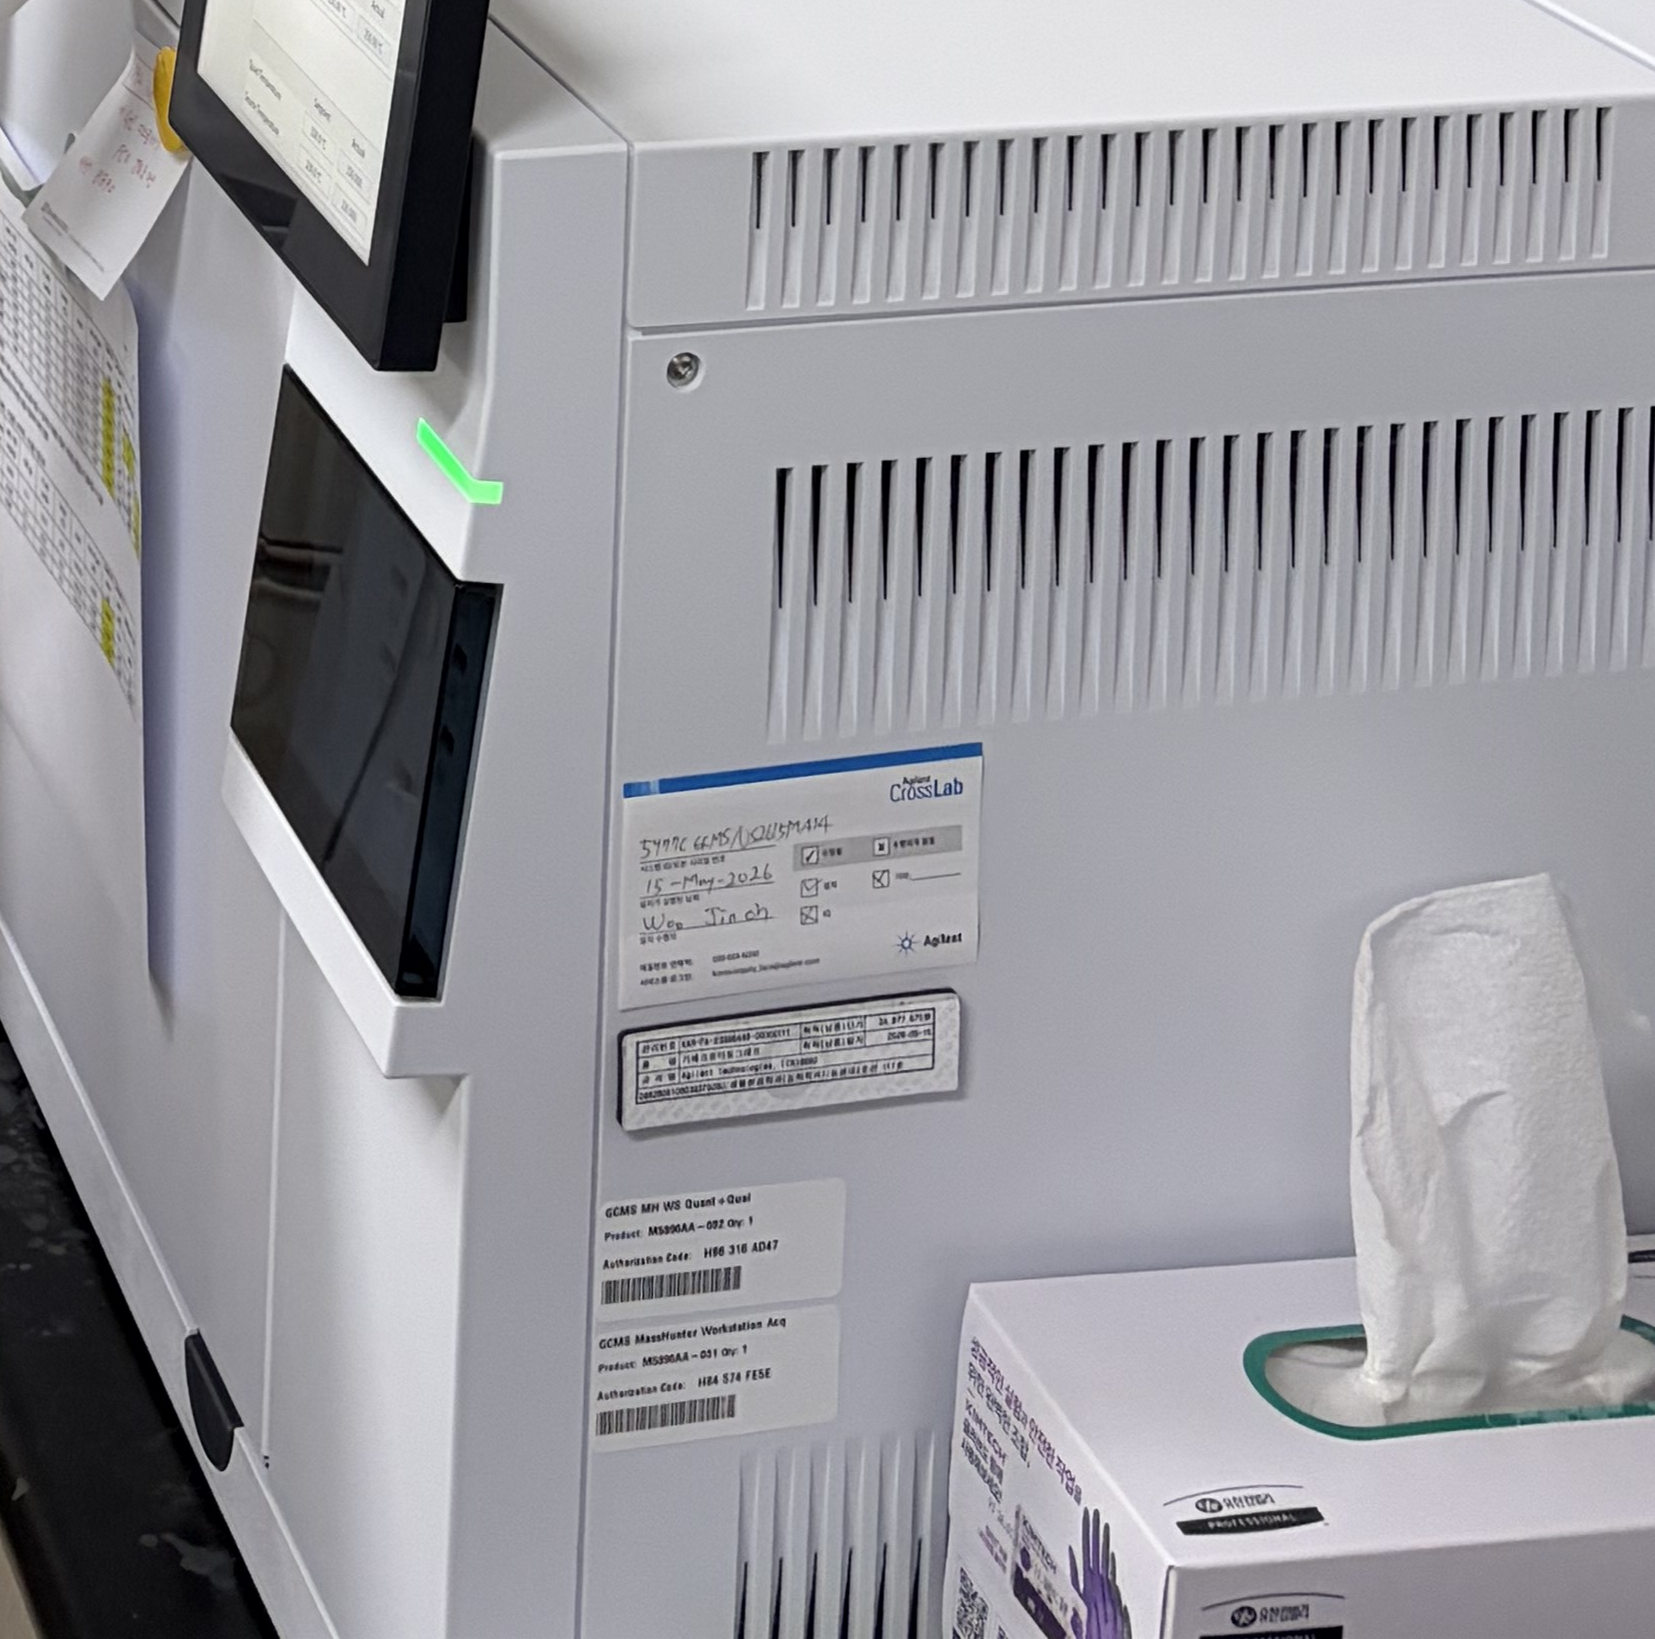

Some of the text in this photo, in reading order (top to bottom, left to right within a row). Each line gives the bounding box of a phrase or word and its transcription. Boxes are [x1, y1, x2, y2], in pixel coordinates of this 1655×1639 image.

[890, 777, 963, 802] CrossLab
[923, 933, 962, 948] Agilent
[605, 1204, 637, 1218] GCMS
[641, 1200, 660, 1214] MH
[663, 1199, 681, 1213] WS
[751, 1239, 779, 1252] AD47
[599, 1317, 786, 1349] GCMS MassHunter Workstation Acq
[965, 1398, 1007, 1465] KIMTECH
[1207, 1513, 1297, 1530] PROFESSIONAL
